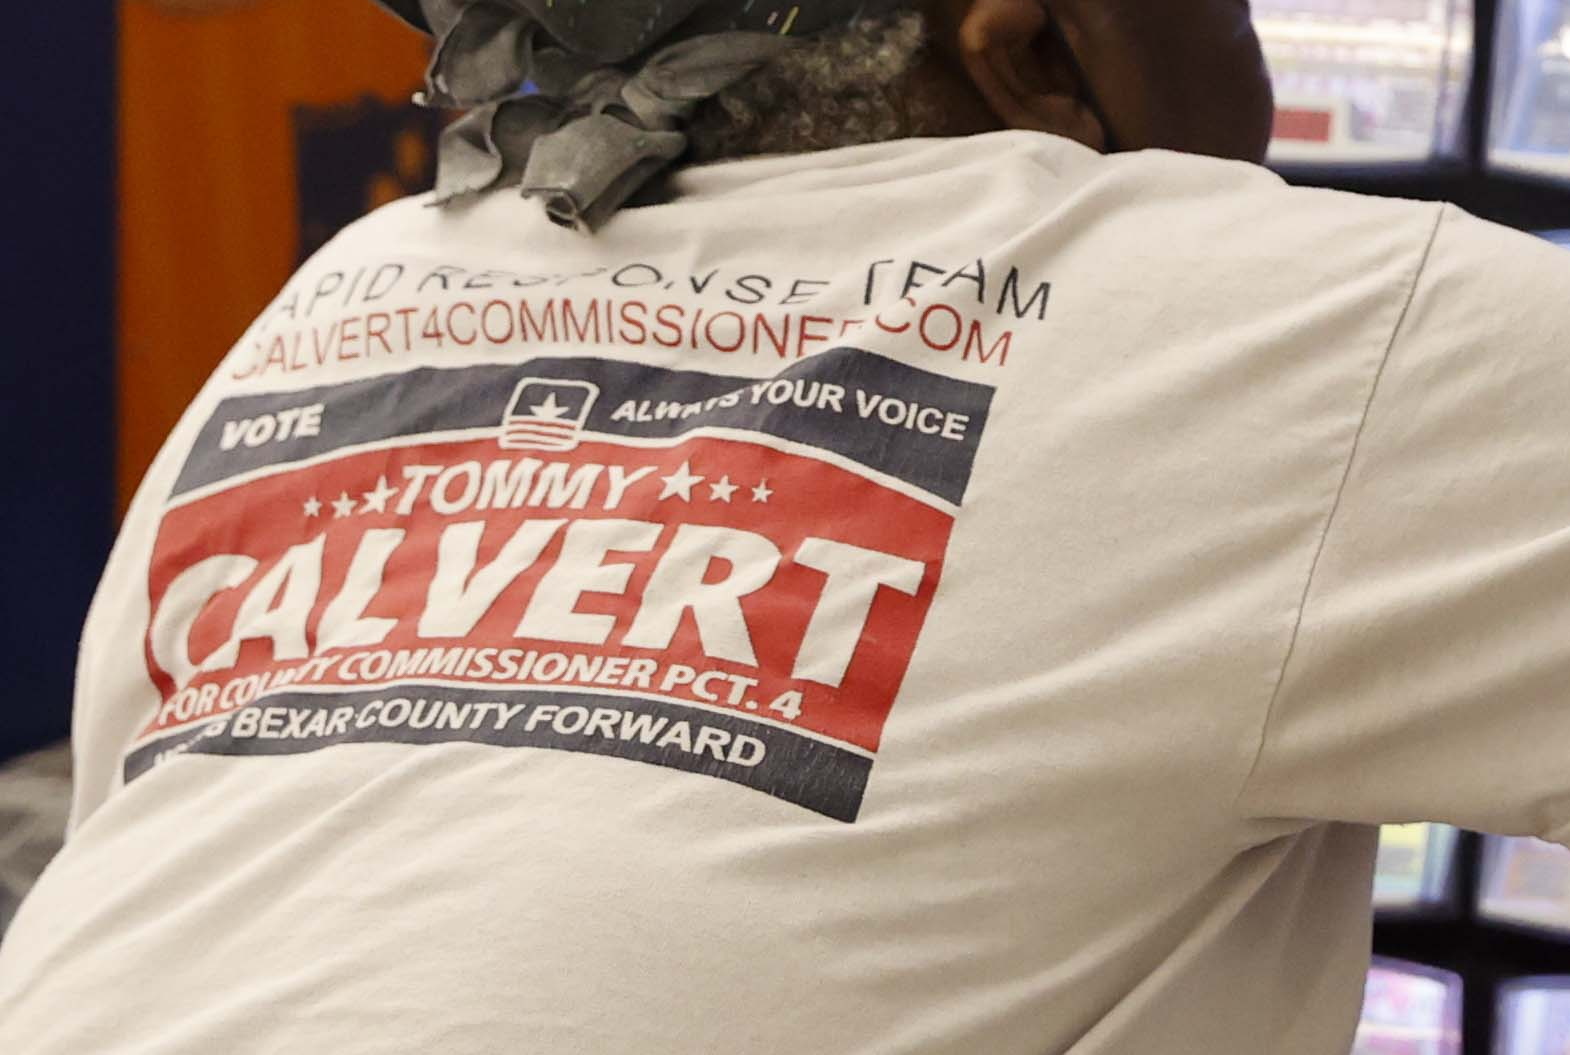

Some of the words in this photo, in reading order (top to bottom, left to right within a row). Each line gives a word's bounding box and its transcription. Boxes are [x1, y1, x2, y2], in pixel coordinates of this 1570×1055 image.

[219, 404, 326, 452] VOTE
[750, 377, 846, 414] YOUR
[855, 389, 971, 442] VOICE
[394, 457, 658, 516] TOMMY
[150, 517, 926, 690] CALVERT
[158, 684, 214, 726] FOR
[337, 647, 656, 689] COMMISSIONER
[663, 664, 759, 711] PCT.
[769, 690, 804, 722] 4
[232, 705, 352, 739] BEXAR
[354, 697, 524, 730] COUNTY
[524, 704, 767, 768] FORWARD
